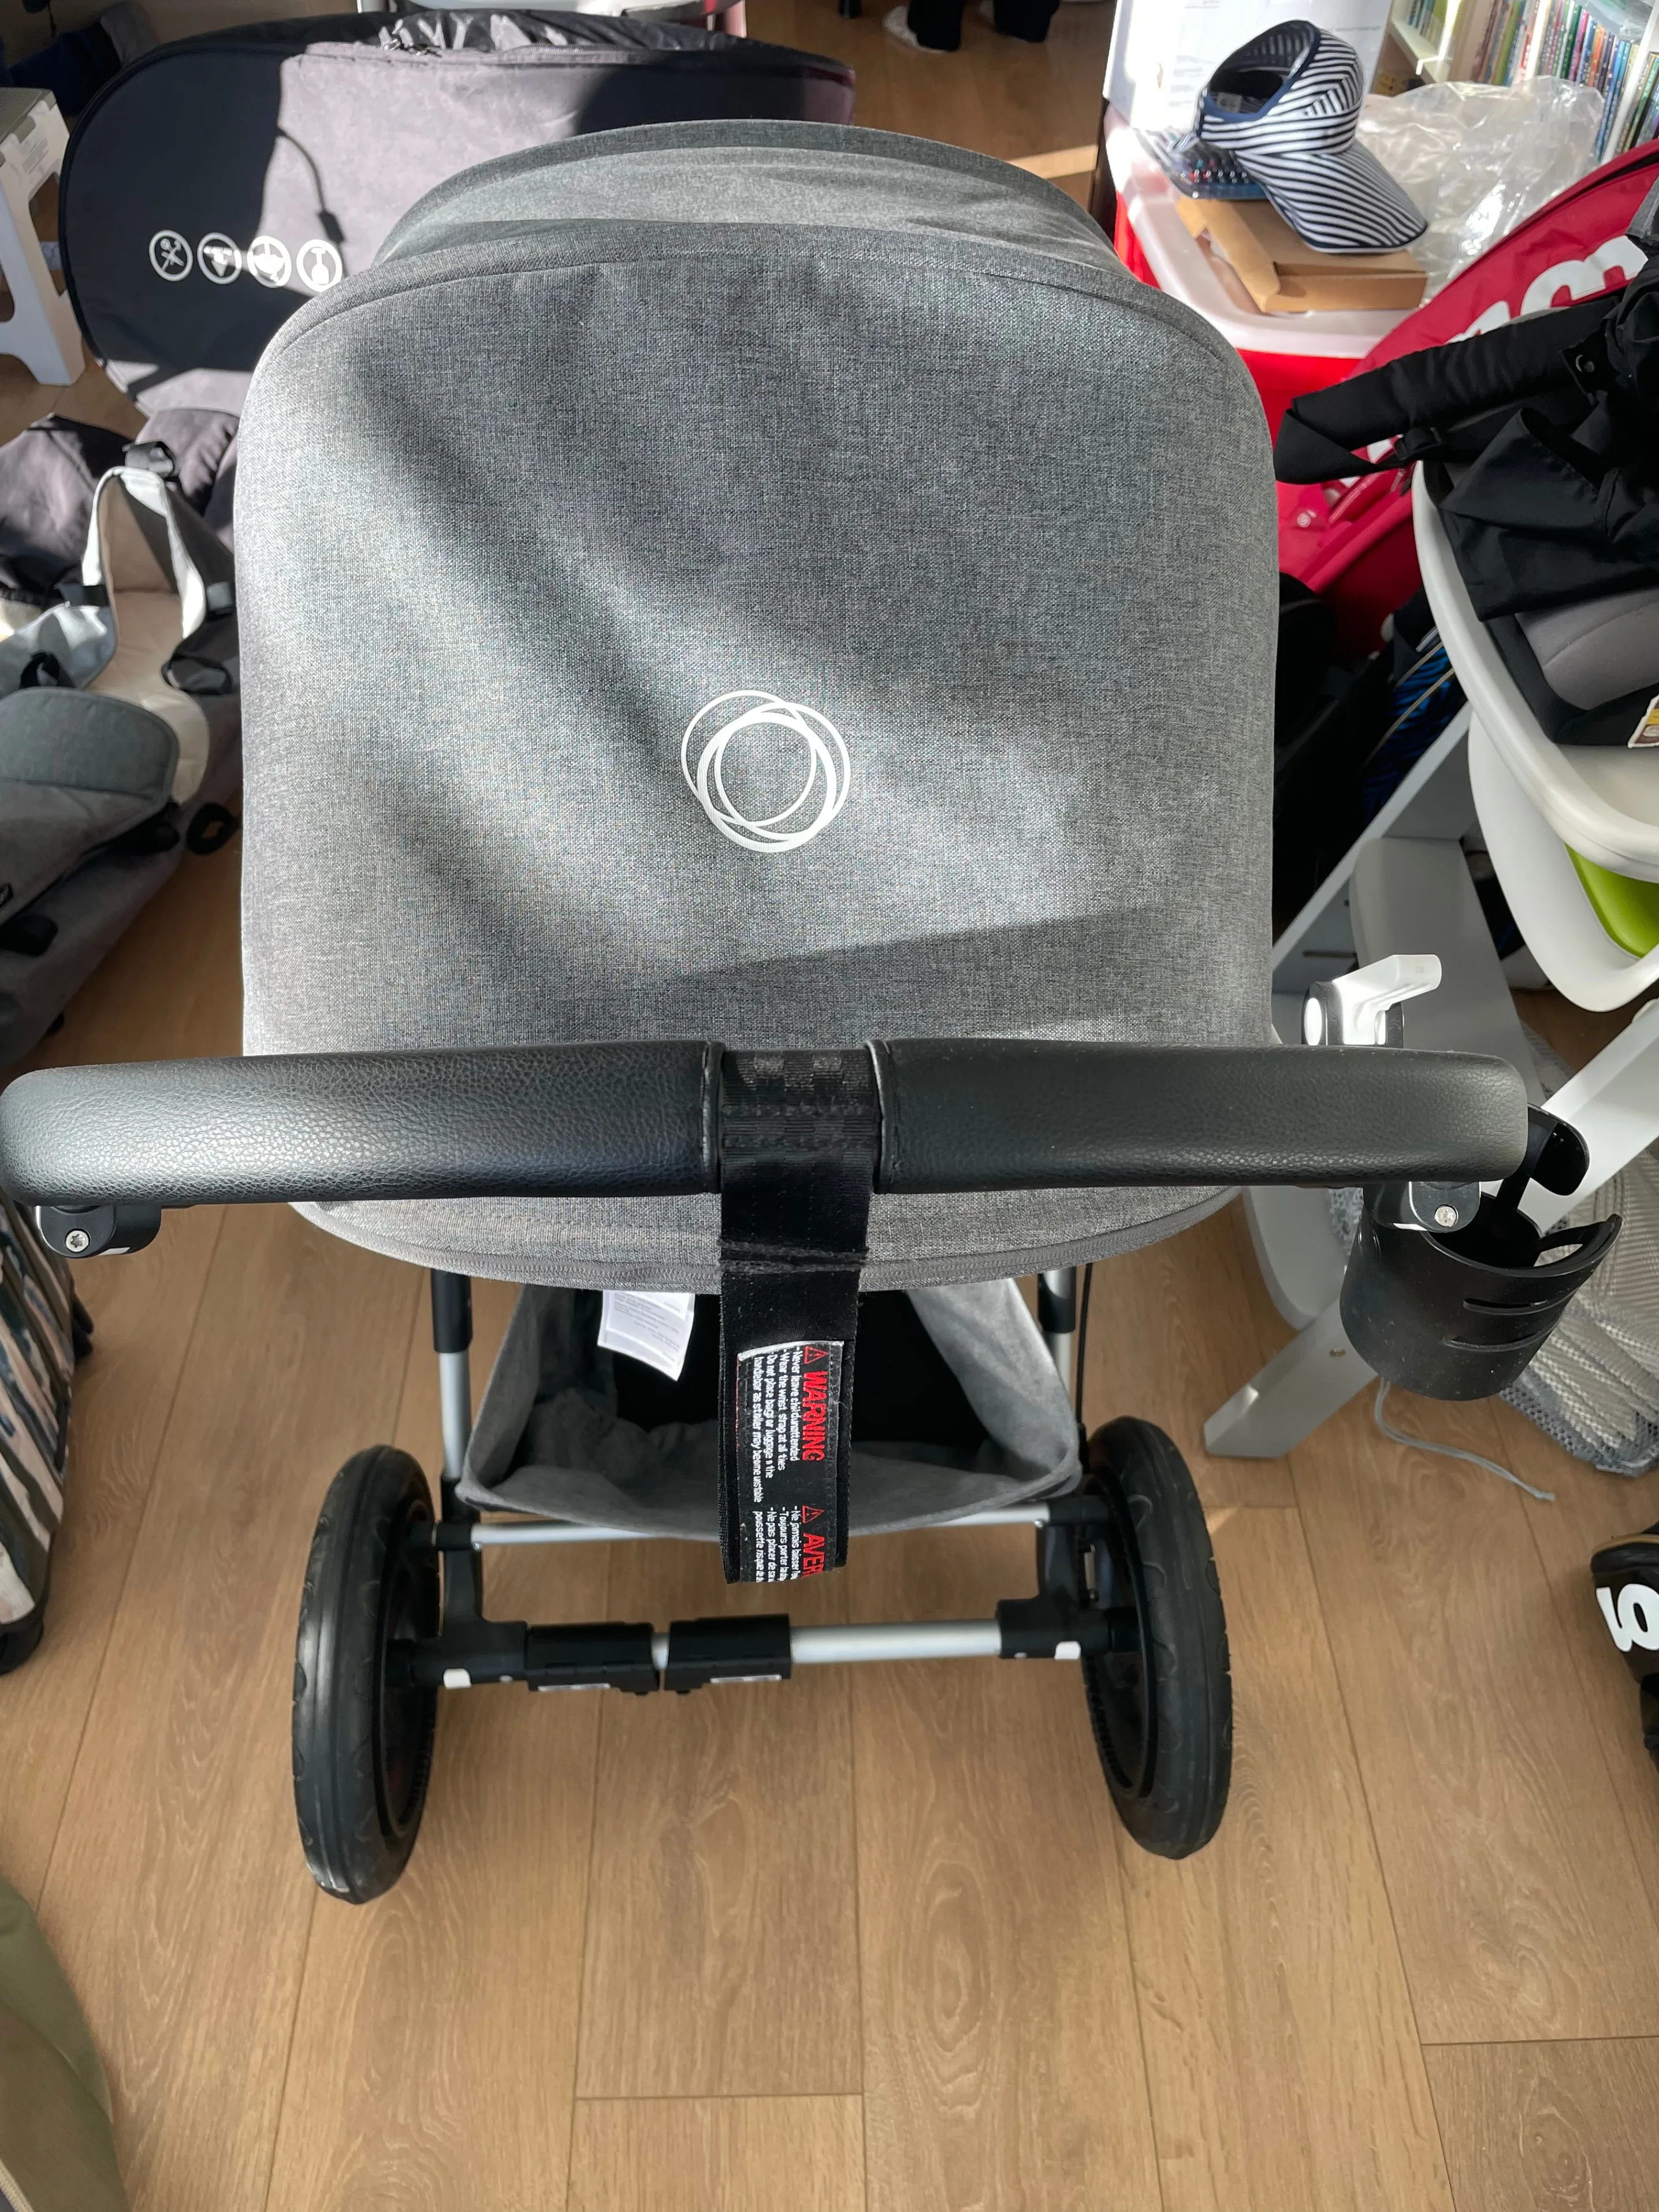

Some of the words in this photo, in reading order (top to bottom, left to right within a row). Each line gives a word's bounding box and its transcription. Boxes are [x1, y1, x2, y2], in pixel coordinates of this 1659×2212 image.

[753, 1357, 764, 1391] handlebar
[766, 1366, 776, 1376] not
[764, 1379, 776, 1398] place
[779, 1375, 788, 1388] the
[791, 1376, 802, 1397] leave
[753, 1393, 762, 1402] as
[778, 1390, 788, 1410] wrist
[764, 1399, 775, 1418] bags
[802, 1371, 828, 1461] WARNING
[766, 1420, 773, 1428] or
[776, 1414, 787, 1433] strap
[751, 1432, 762, 1448] may
[764, 1429, 775, 1458] luggage
[778, 1434, 787, 1443] at
[778, 1444, 787, 1452] all
[766, 1466, 775, 1478] the
[754, 1476, 764, 1502] unstable
[753, 1511, 765, 1548] poussette
[765, 1522, 776, 1537] pas
[790, 1522, 801, 1548] jamais
[766, 1539, 778, 1561] placer
[778, 1545, 788, 1565] porter
[792, 1549, 801, 1570] laisser
[754, 1550, 765, 1570] risque
[768, 1562, 777, 1570] de
